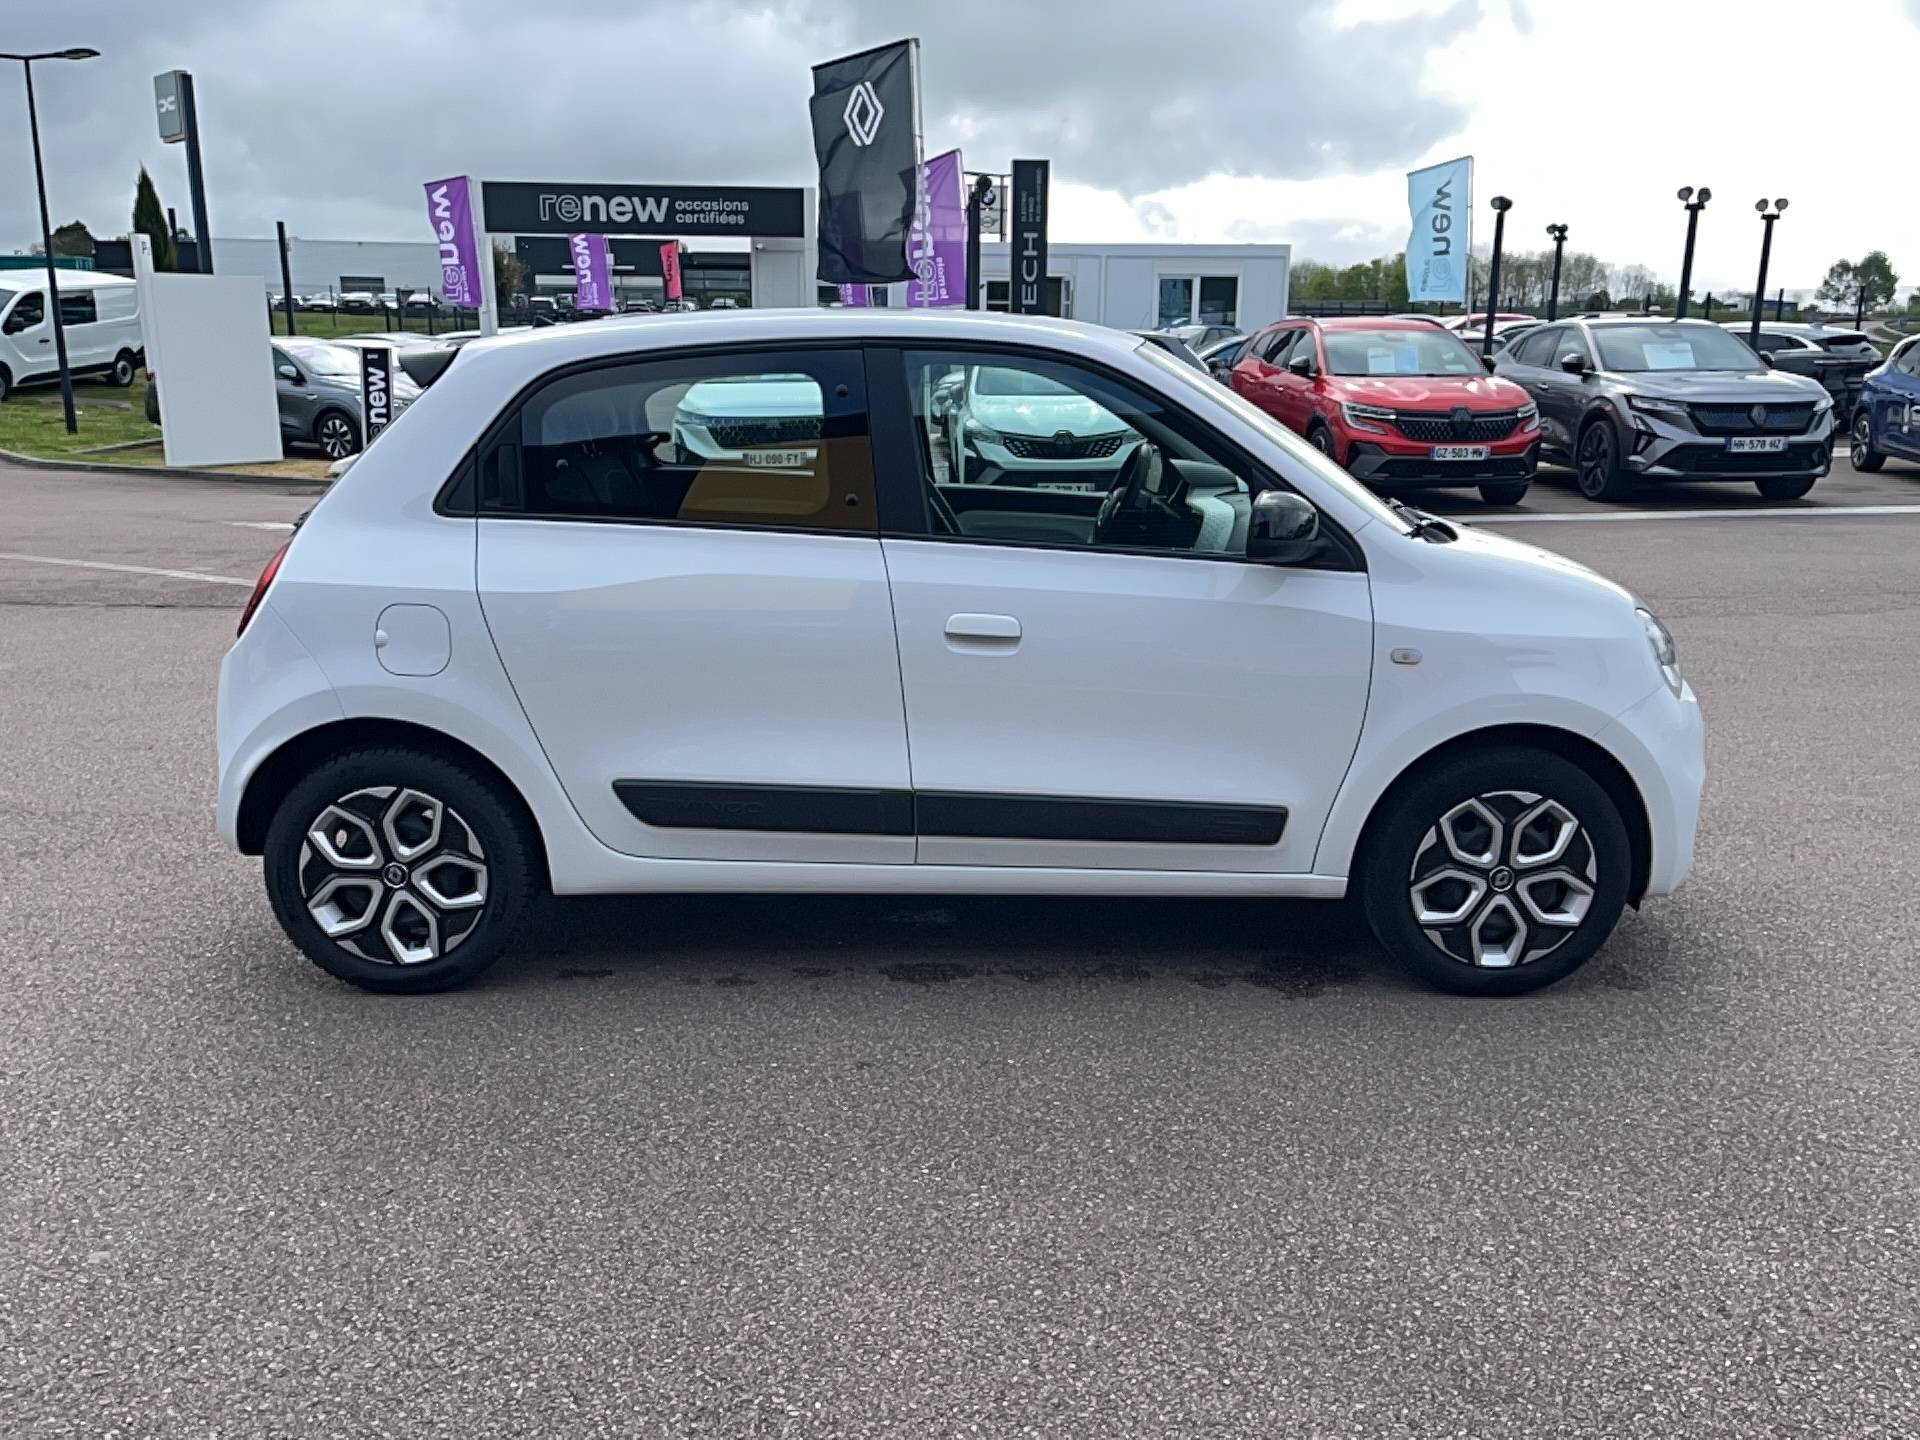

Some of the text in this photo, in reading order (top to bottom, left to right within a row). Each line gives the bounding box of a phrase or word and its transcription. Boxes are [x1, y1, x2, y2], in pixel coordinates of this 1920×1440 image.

[539, 194, 669, 223] renew
[674, 199, 749, 211] occasions
[675, 211, 745, 224] certifiées
[1021, 232, 1038, 313] ECH
